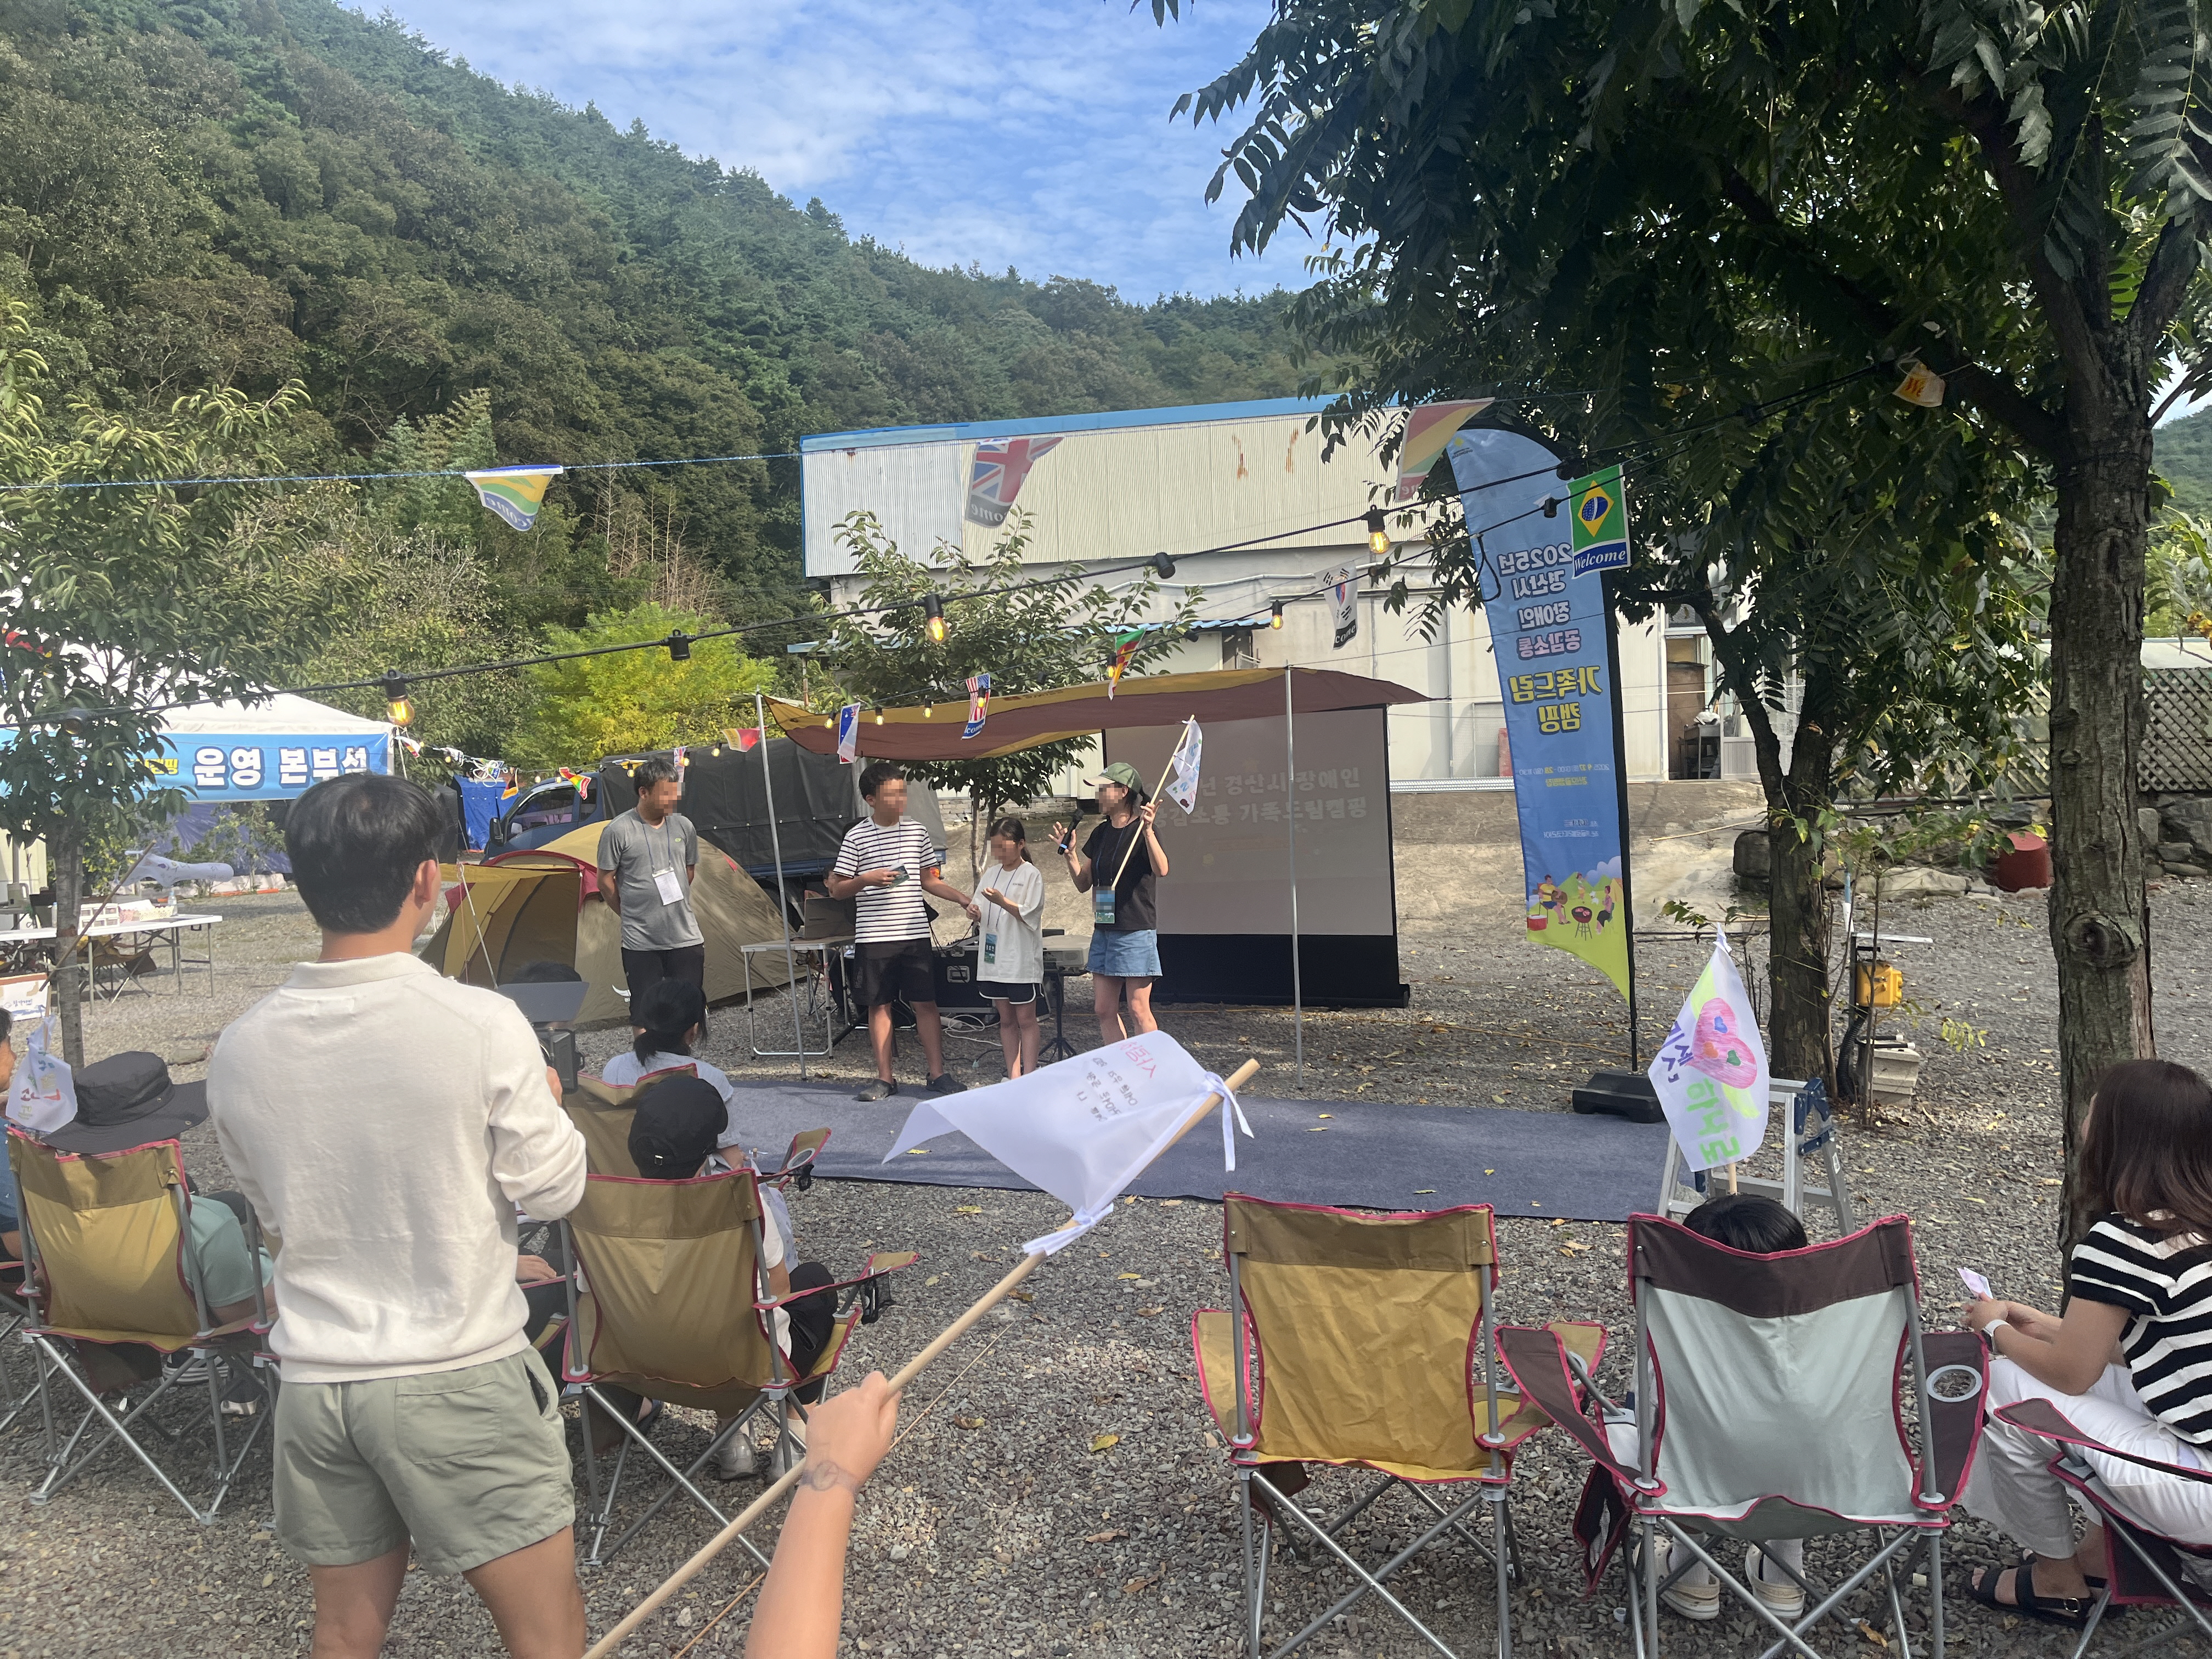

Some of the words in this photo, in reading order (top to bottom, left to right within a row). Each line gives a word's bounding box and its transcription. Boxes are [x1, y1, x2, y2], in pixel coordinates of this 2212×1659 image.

[1573, 548, 1627, 572] Welcome
[194, 748, 261, 786] 운영
[280, 747, 367, 784] 본부석
[1225, 774, 1287, 796] 경산시
[1294, 768, 1360, 792] 장애인
[1685, 1077, 1741, 1165] 하나로
